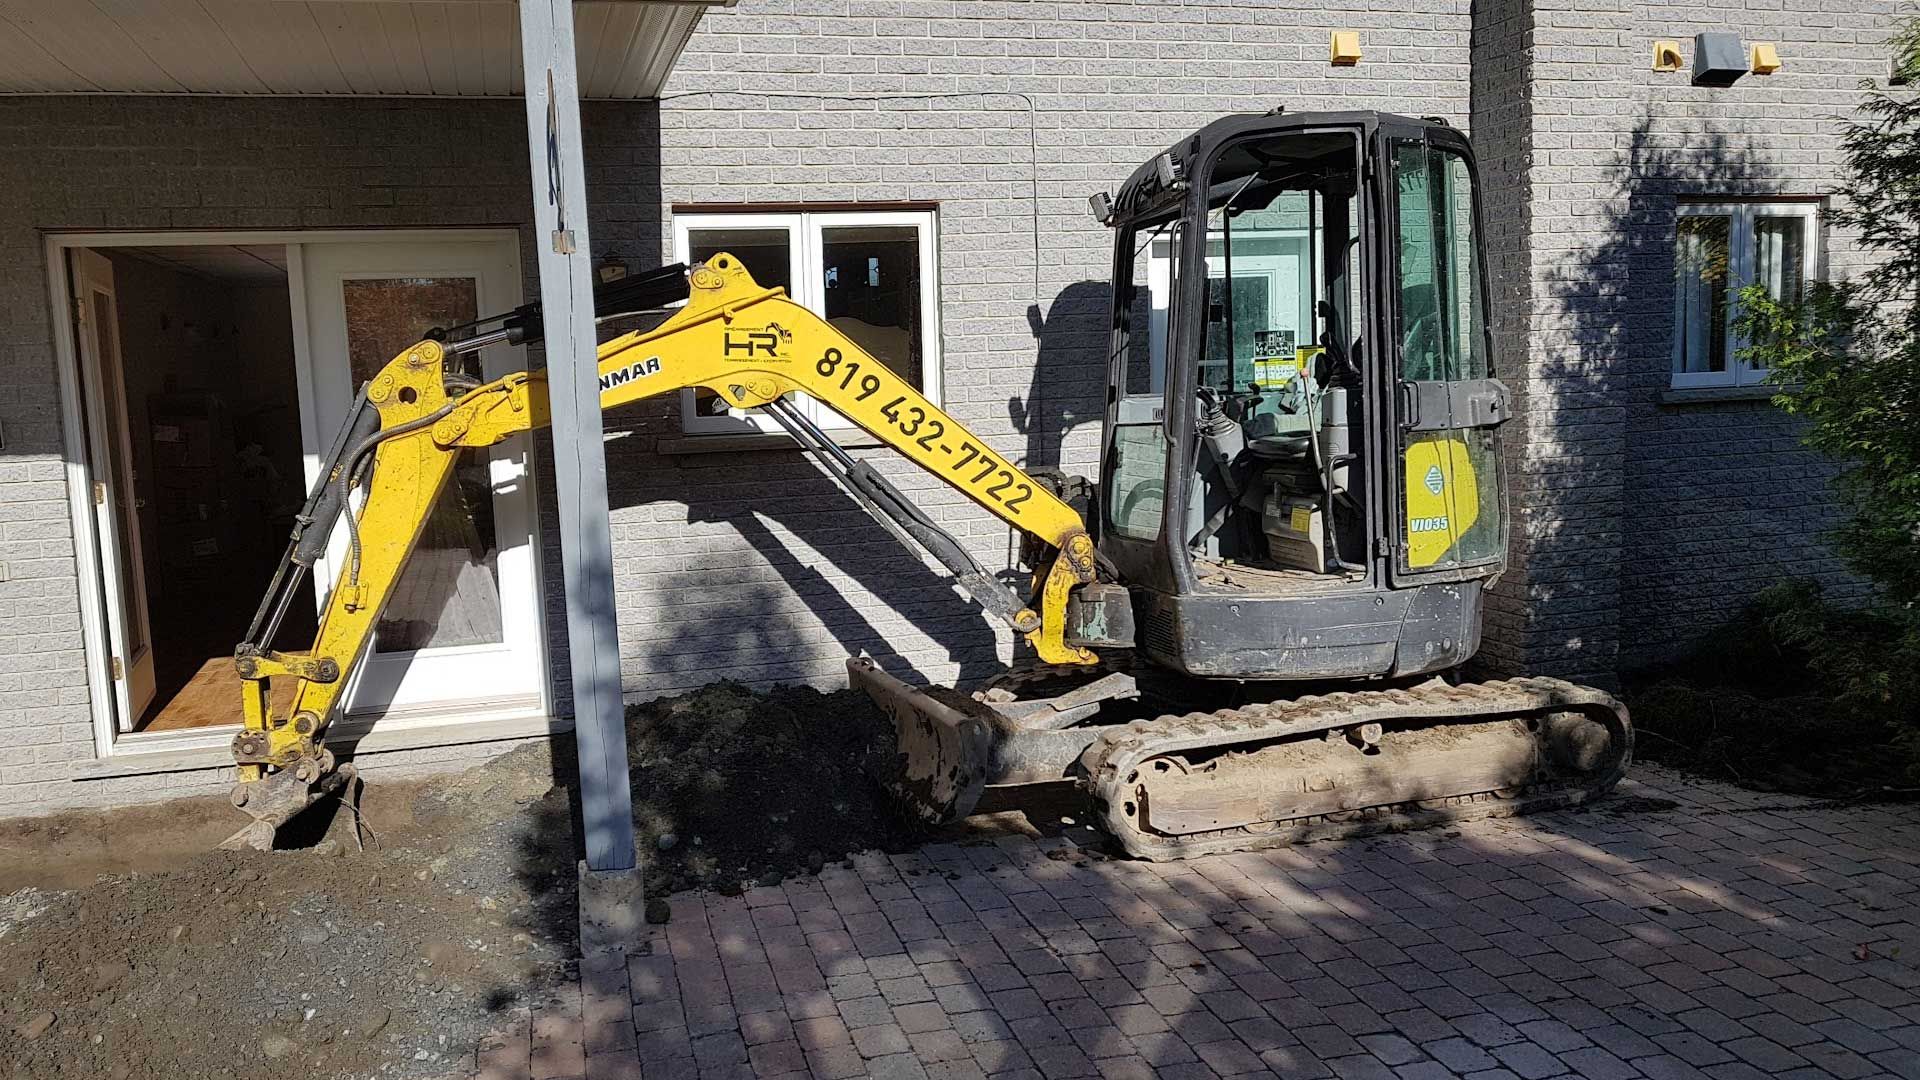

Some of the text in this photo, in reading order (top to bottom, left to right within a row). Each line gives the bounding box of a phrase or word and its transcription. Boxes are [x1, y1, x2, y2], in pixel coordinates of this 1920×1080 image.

[724, 333, 778, 357] HR
[599, 357, 660, 391] NMAR
[816, 347, 1033, 515] 819 432-7722
